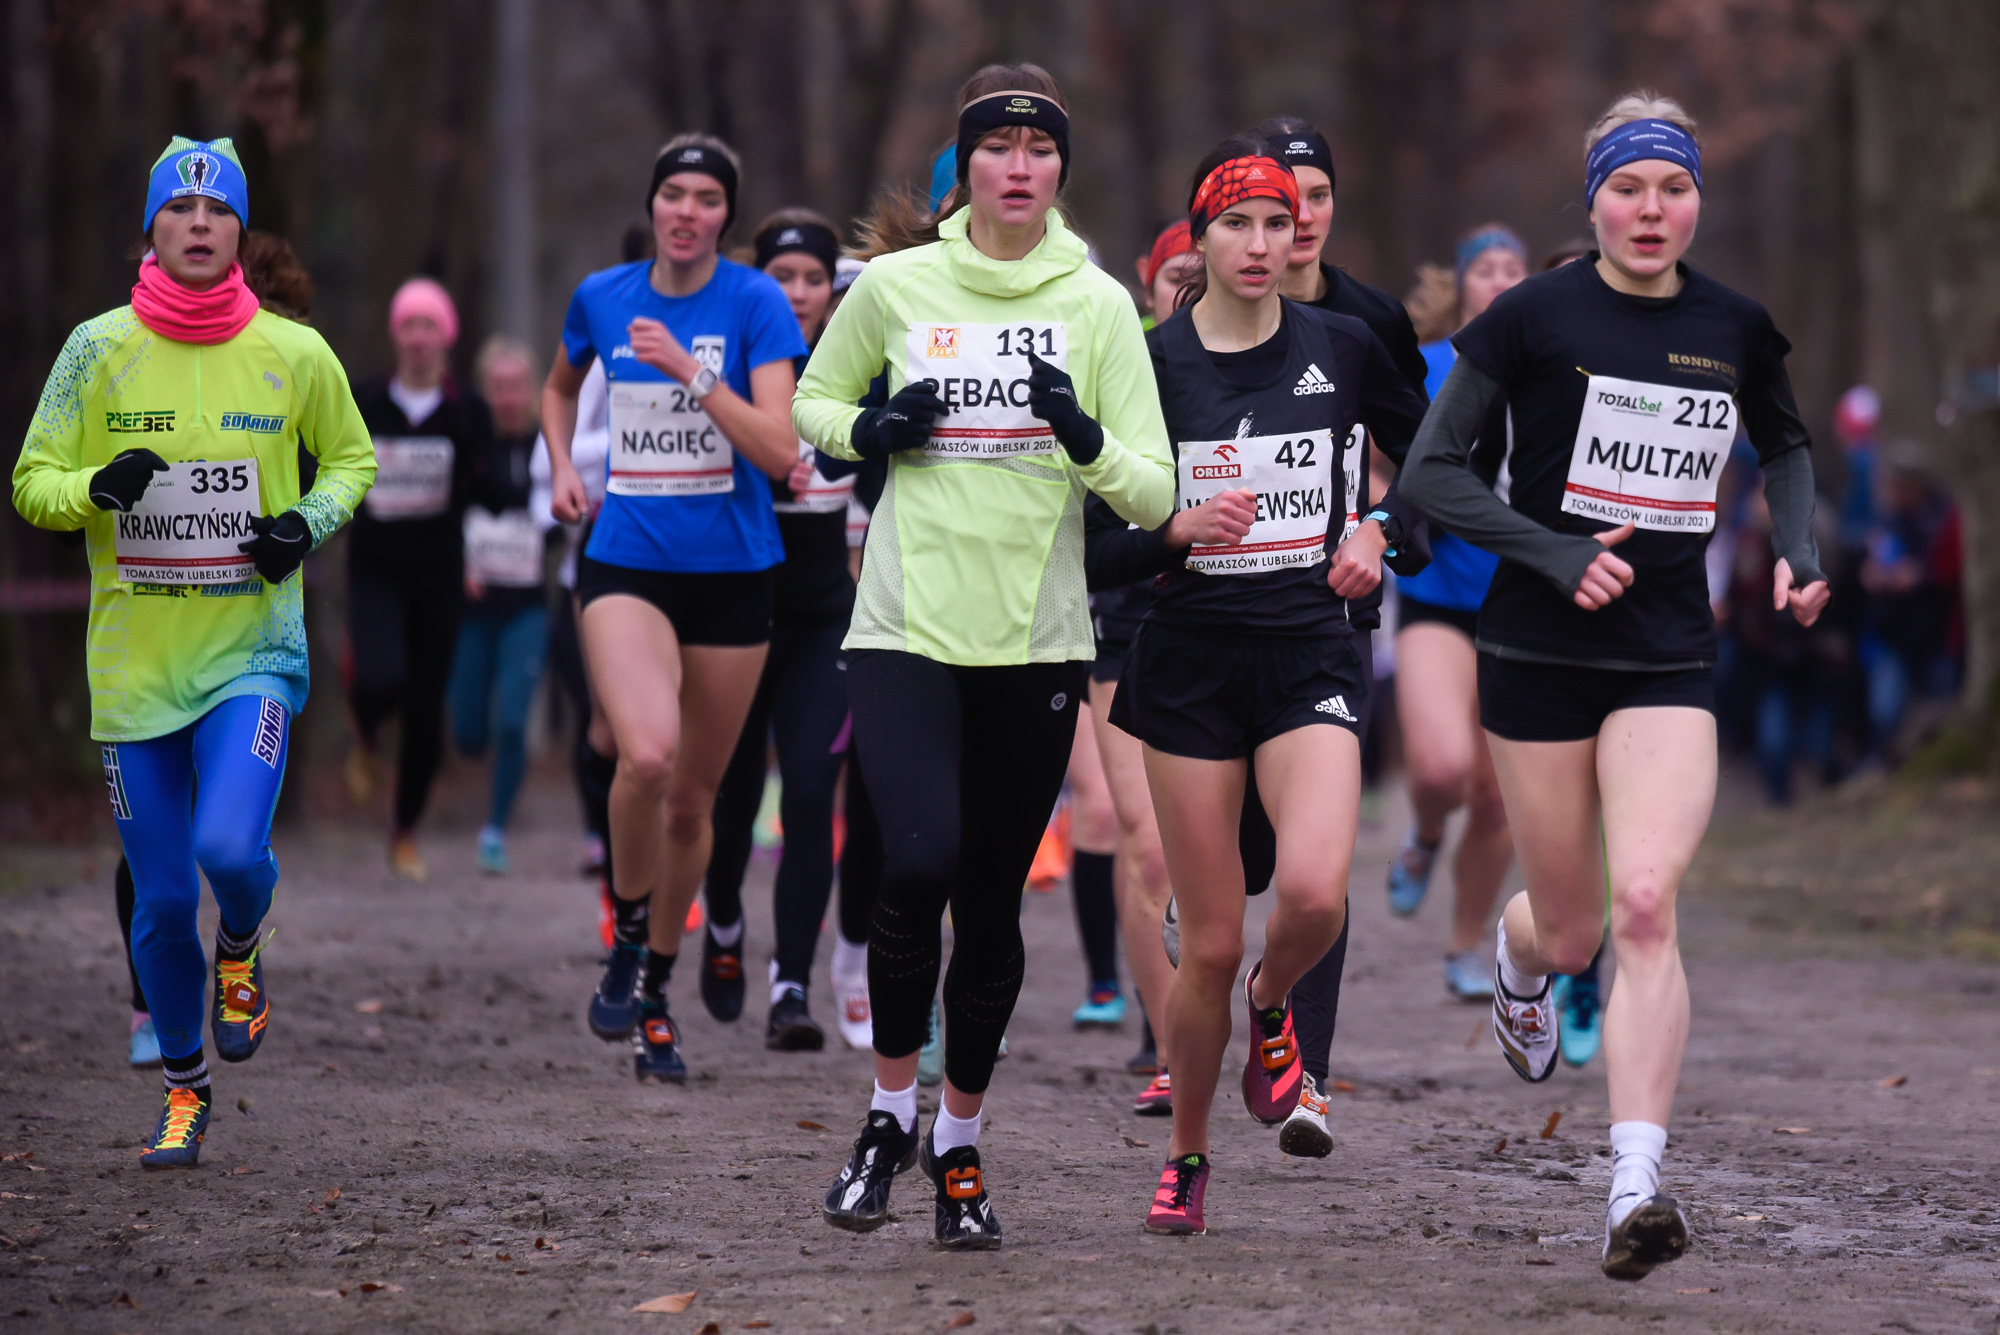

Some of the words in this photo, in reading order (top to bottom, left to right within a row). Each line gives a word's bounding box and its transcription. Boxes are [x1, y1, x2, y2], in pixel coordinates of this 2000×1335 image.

[929, 348, 956, 357] PZLA
[996, 327, 1057, 357] 131
[1293, 382, 1335, 396] adidas
[1597, 391, 1662, 412] TOTALbet
[220, 411, 288, 434] SONAROL
[1673, 396, 1730, 430] 212
[622, 425, 716, 459] NAGIĘĆ
[923, 441, 980, 453] OMASZÓW
[982, 442, 1030, 453] LUBELSKI
[1275, 438, 1317, 469] 42
[1586, 436, 1717, 480] MULTAN
[191, 465, 249, 494] 335
[1194, 466, 1239, 478] ORLEN
[118, 507, 257, 541] KRAWCZYŃSKA
[1572, 498, 1641, 521] TOMASZÓW
[1644, 512, 1686, 526] LUBELSKI
[1687, 516, 1709, 527] 2021
[125, 568, 184, 580] TOMASZÓW
[188, 569, 232, 580] LUBELSKI
[1191, 555, 1258, 570] TOMASZÓW
[1262, 553, 1308, 566] LUBELSKI
